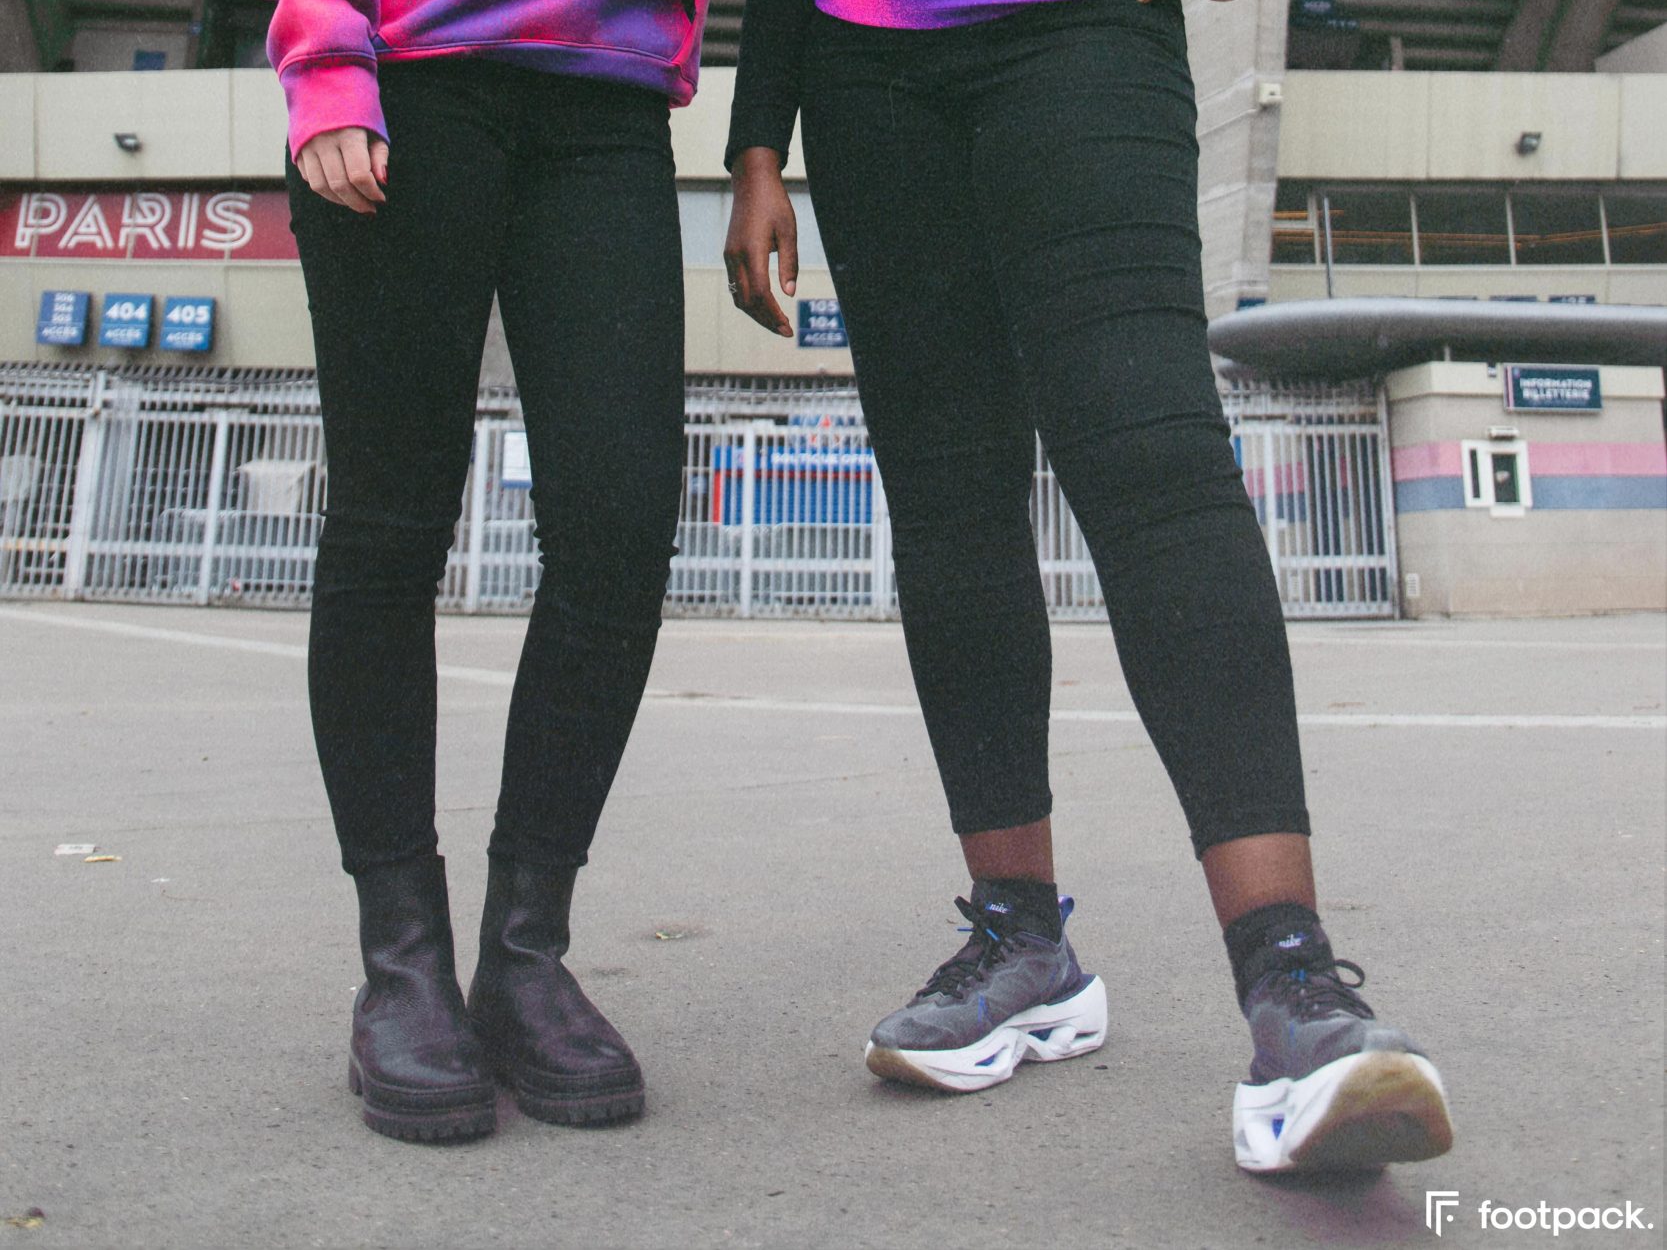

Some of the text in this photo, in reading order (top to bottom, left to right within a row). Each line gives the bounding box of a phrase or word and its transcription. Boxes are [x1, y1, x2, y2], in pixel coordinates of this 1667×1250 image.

[14, 192, 253, 249] PARIS
[105, 301, 147, 321] 404
[166, 304, 211, 325] 405
